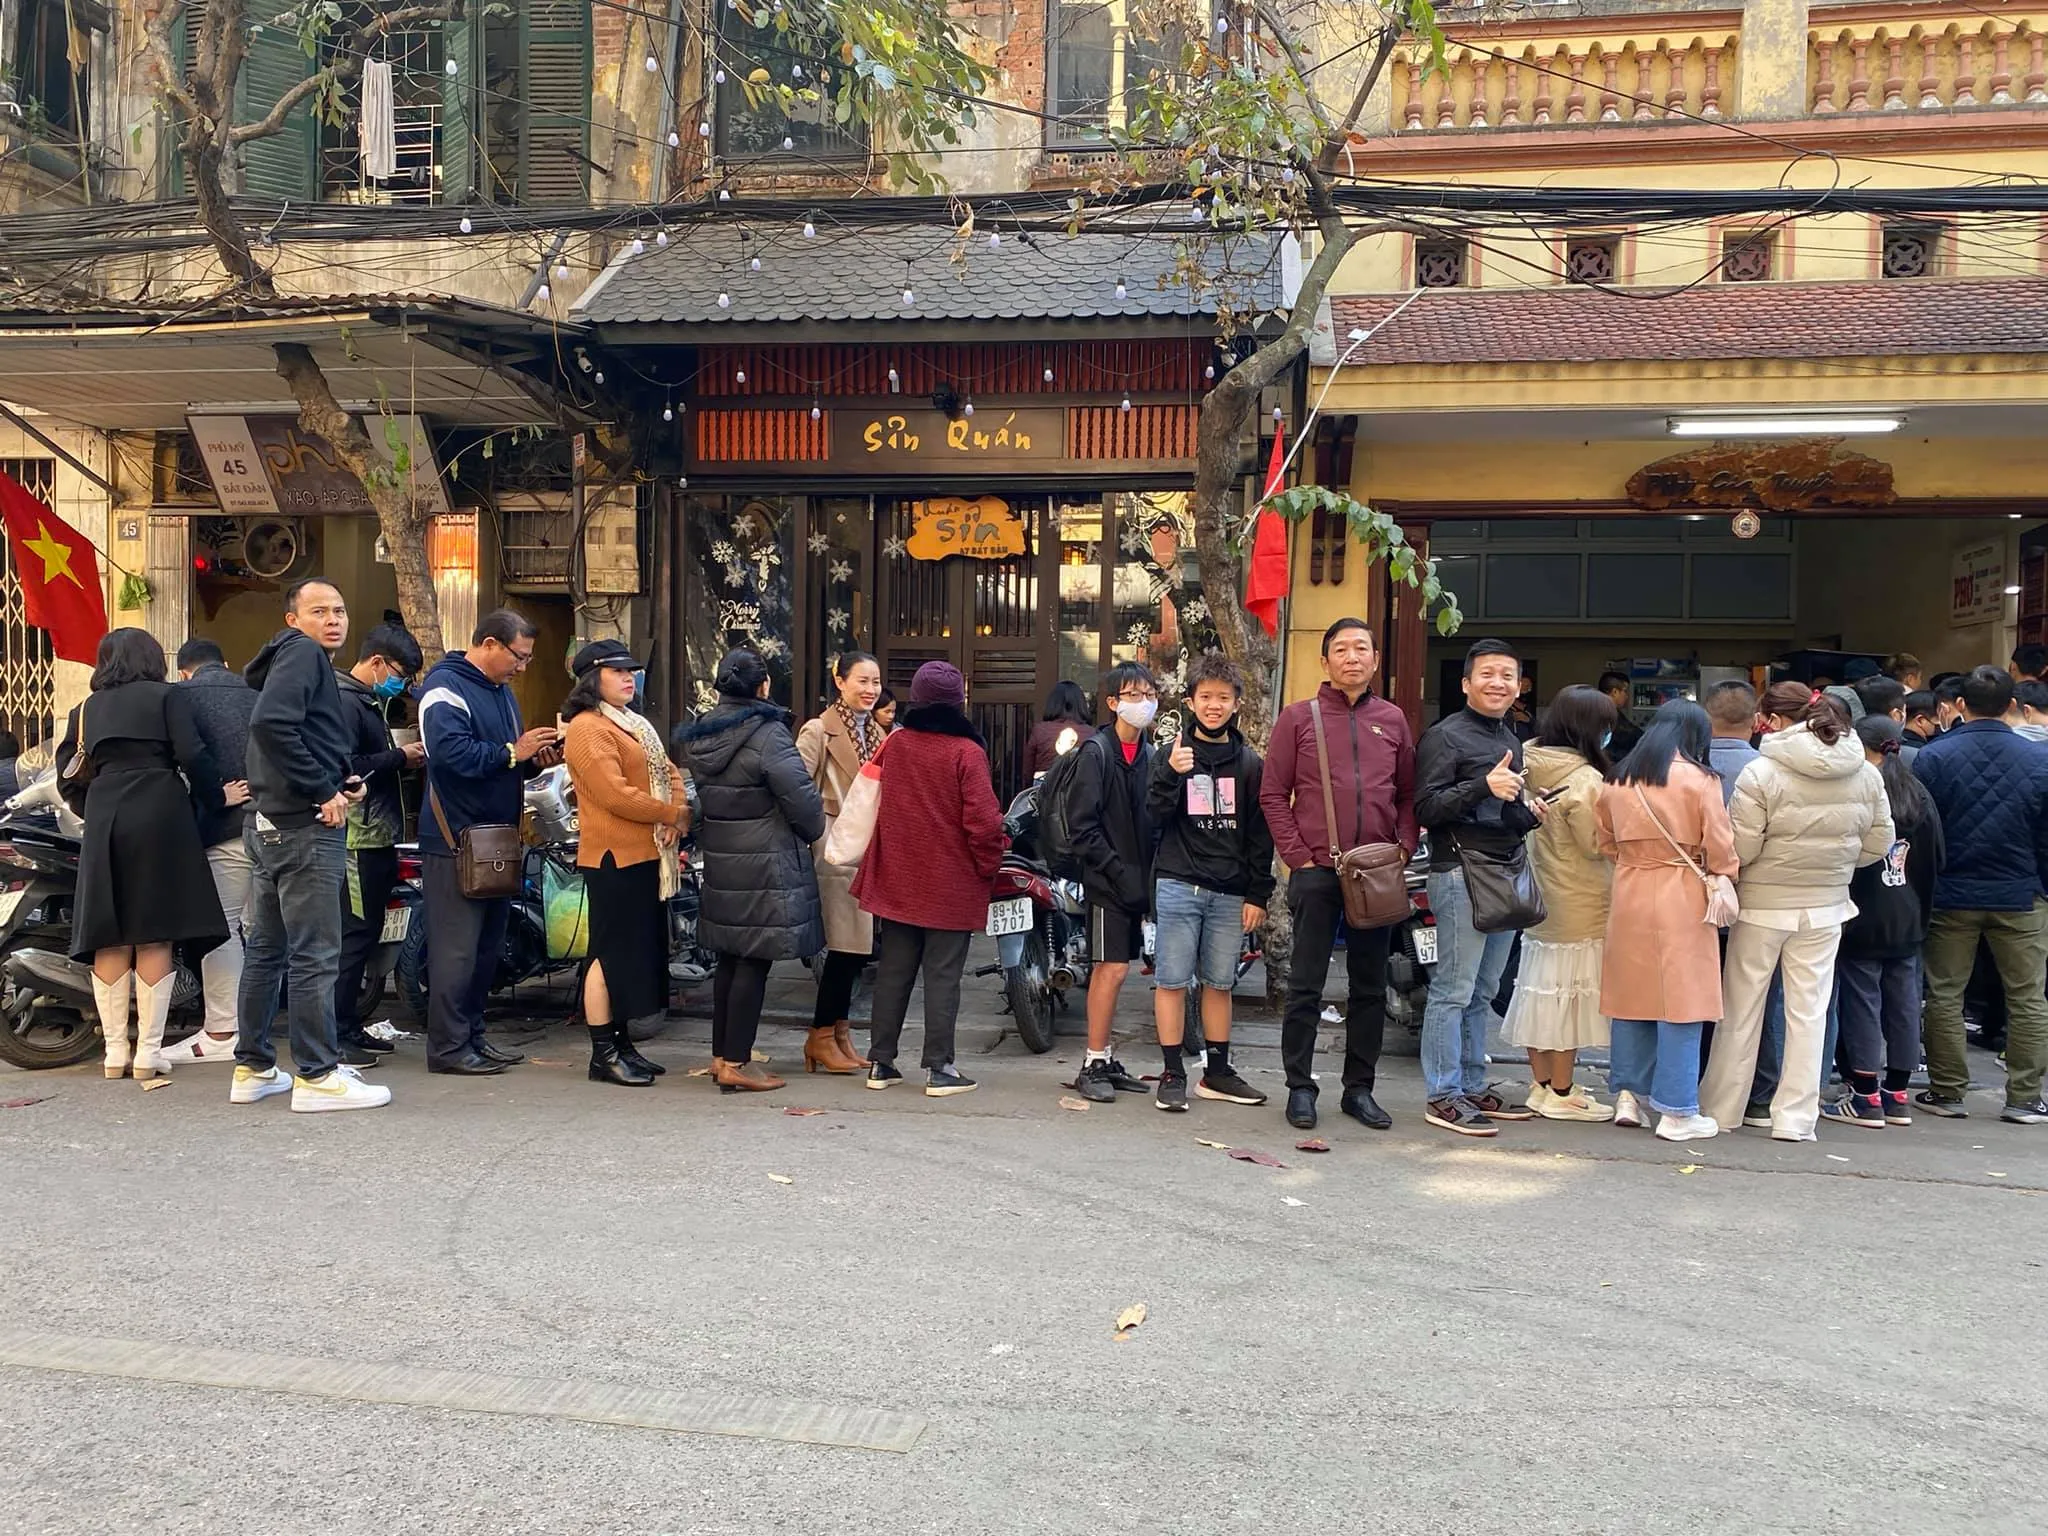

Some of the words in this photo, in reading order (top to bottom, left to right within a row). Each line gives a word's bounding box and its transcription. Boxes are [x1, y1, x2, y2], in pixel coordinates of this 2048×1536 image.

[947, 411, 1031, 450] Quán
[223, 460, 248, 475] 45
[122, 521, 137, 537] 45
[722, 600, 760, 620] Merry
[993, 915, 1025, 933] 6707
